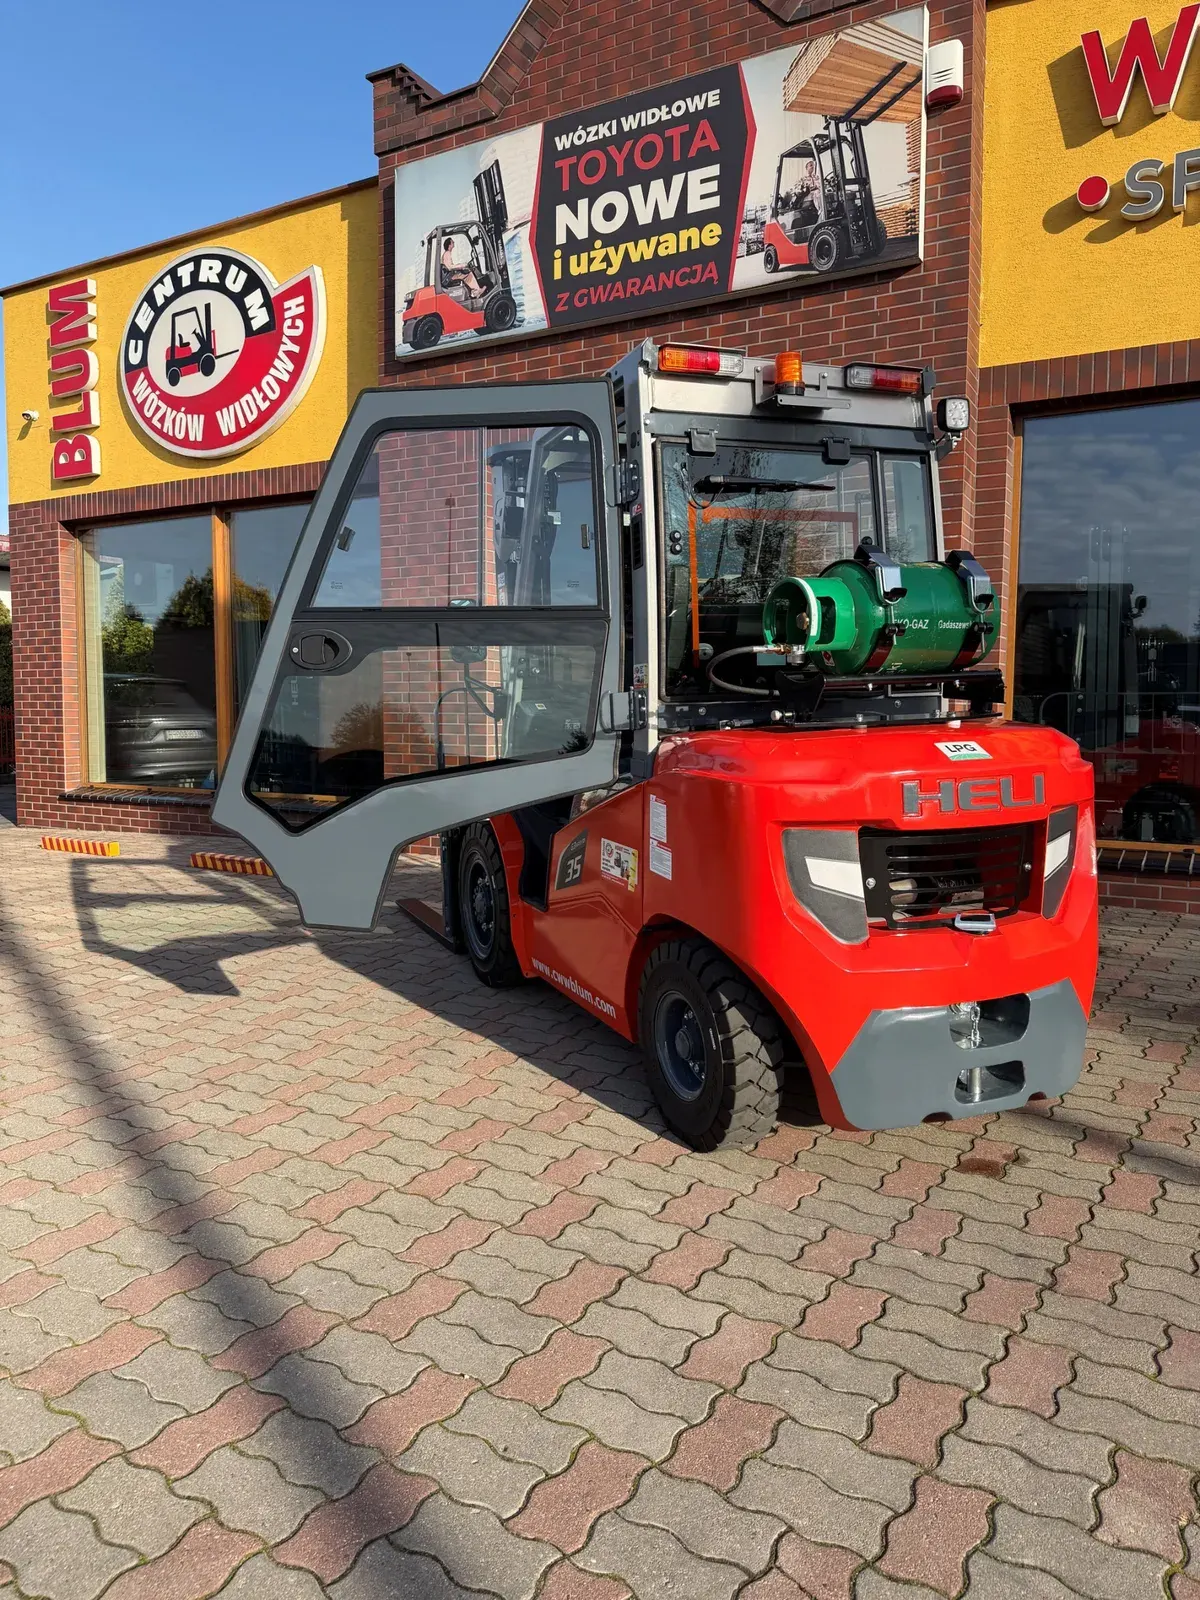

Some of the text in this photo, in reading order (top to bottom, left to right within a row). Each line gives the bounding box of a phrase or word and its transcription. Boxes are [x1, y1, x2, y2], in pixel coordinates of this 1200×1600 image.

[1080, 2, 1200, 126] W
[554, 88, 721, 151] WÓZKI WIDŁOWE
[554, 118, 721, 191] TOYOTA
[555, 163, 721, 245] NOWE
[553, 249, 562, 280] i
[569, 222, 723, 276] używane
[128, 258, 270, 365] CENTRUM
[554, 261, 719, 312] Z GWARANCJĄ
[48, 277, 101, 481] BLUM
[131, 294, 306, 442] WÓZKÓW WIDŁOWYCH
[944, 743, 978, 753] LPG
[902, 773, 1046, 815] HELI
[564, 854, 583, 883] 35
[531, 956, 617, 1019] www.cwwblum.com
